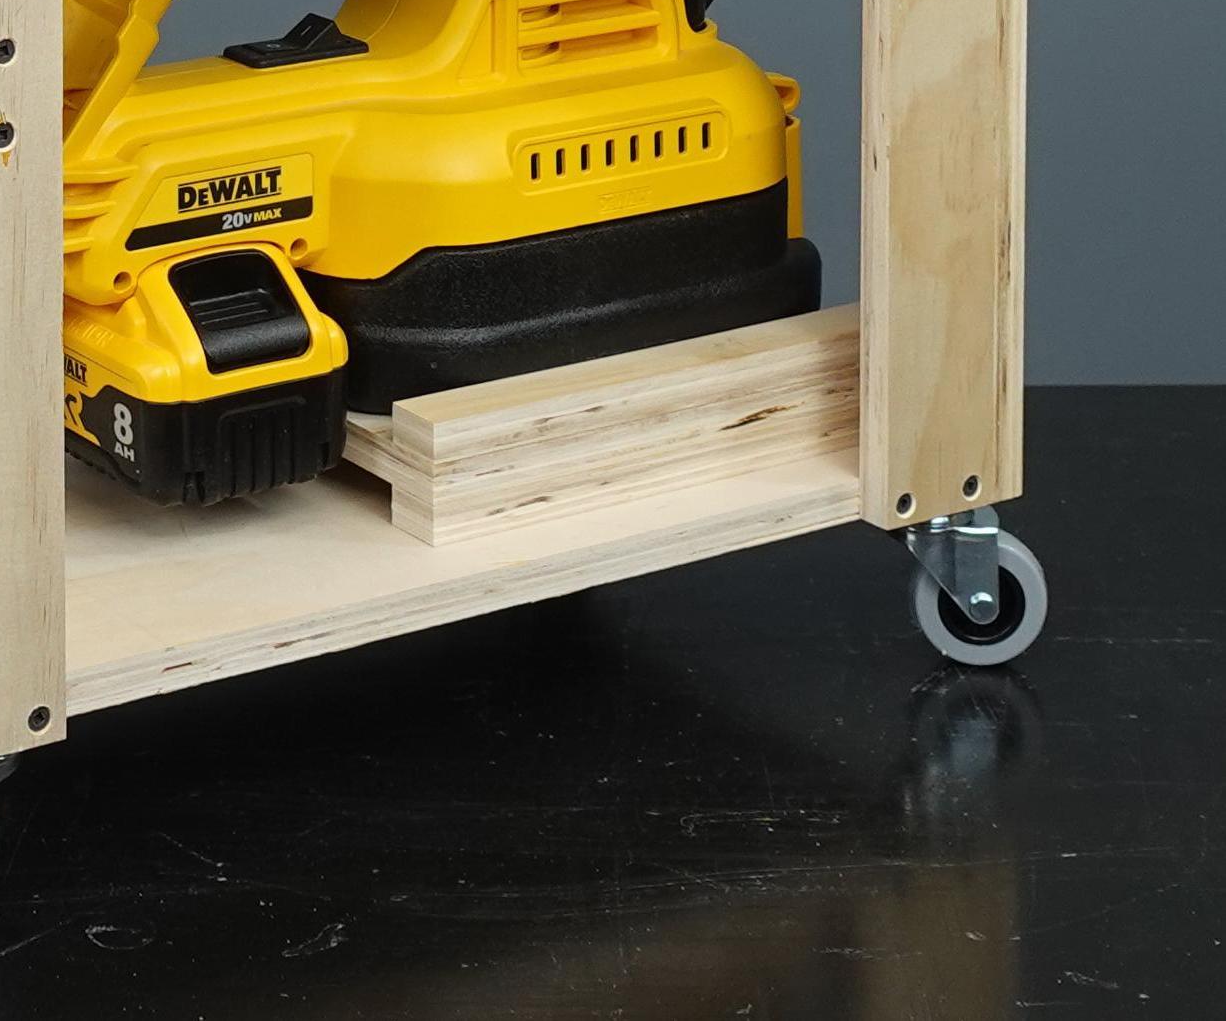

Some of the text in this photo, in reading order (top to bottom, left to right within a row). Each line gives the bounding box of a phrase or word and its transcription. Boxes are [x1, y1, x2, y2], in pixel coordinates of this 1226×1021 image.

[177, 168, 282, 211] DEWALT
[64, 354, 87, 383] ALT
[113, 402, 134, 445] 8
[114, 442, 135, 463] AH
